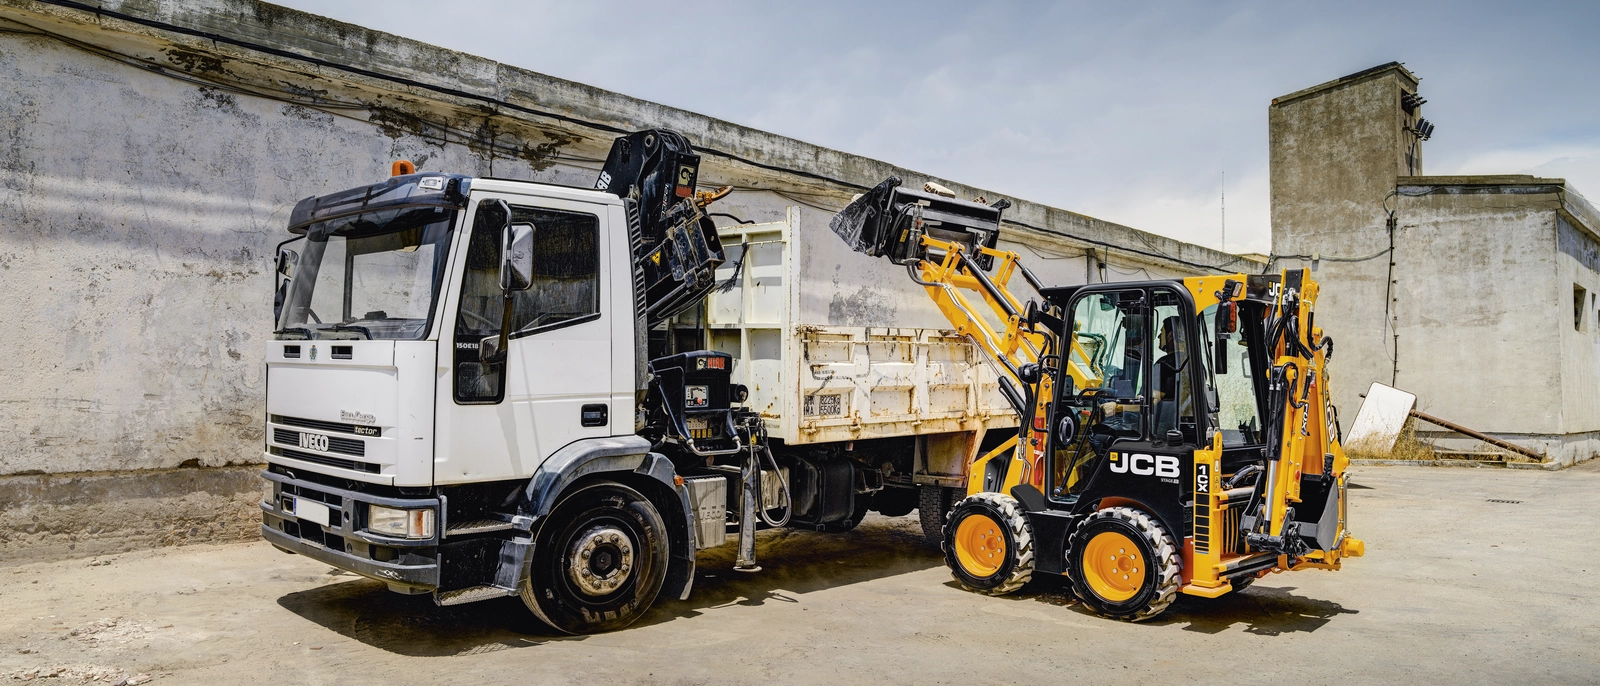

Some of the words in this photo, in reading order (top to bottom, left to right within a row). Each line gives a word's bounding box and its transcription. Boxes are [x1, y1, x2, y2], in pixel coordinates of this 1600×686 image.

[456, 342, 479, 350] 150E18
[355, 426, 377, 435] tector
[298, 432, 329, 452] IVECO
[1109, 452, 1180, 478] JCB
[1197, 465, 1209, 492] 1CX
